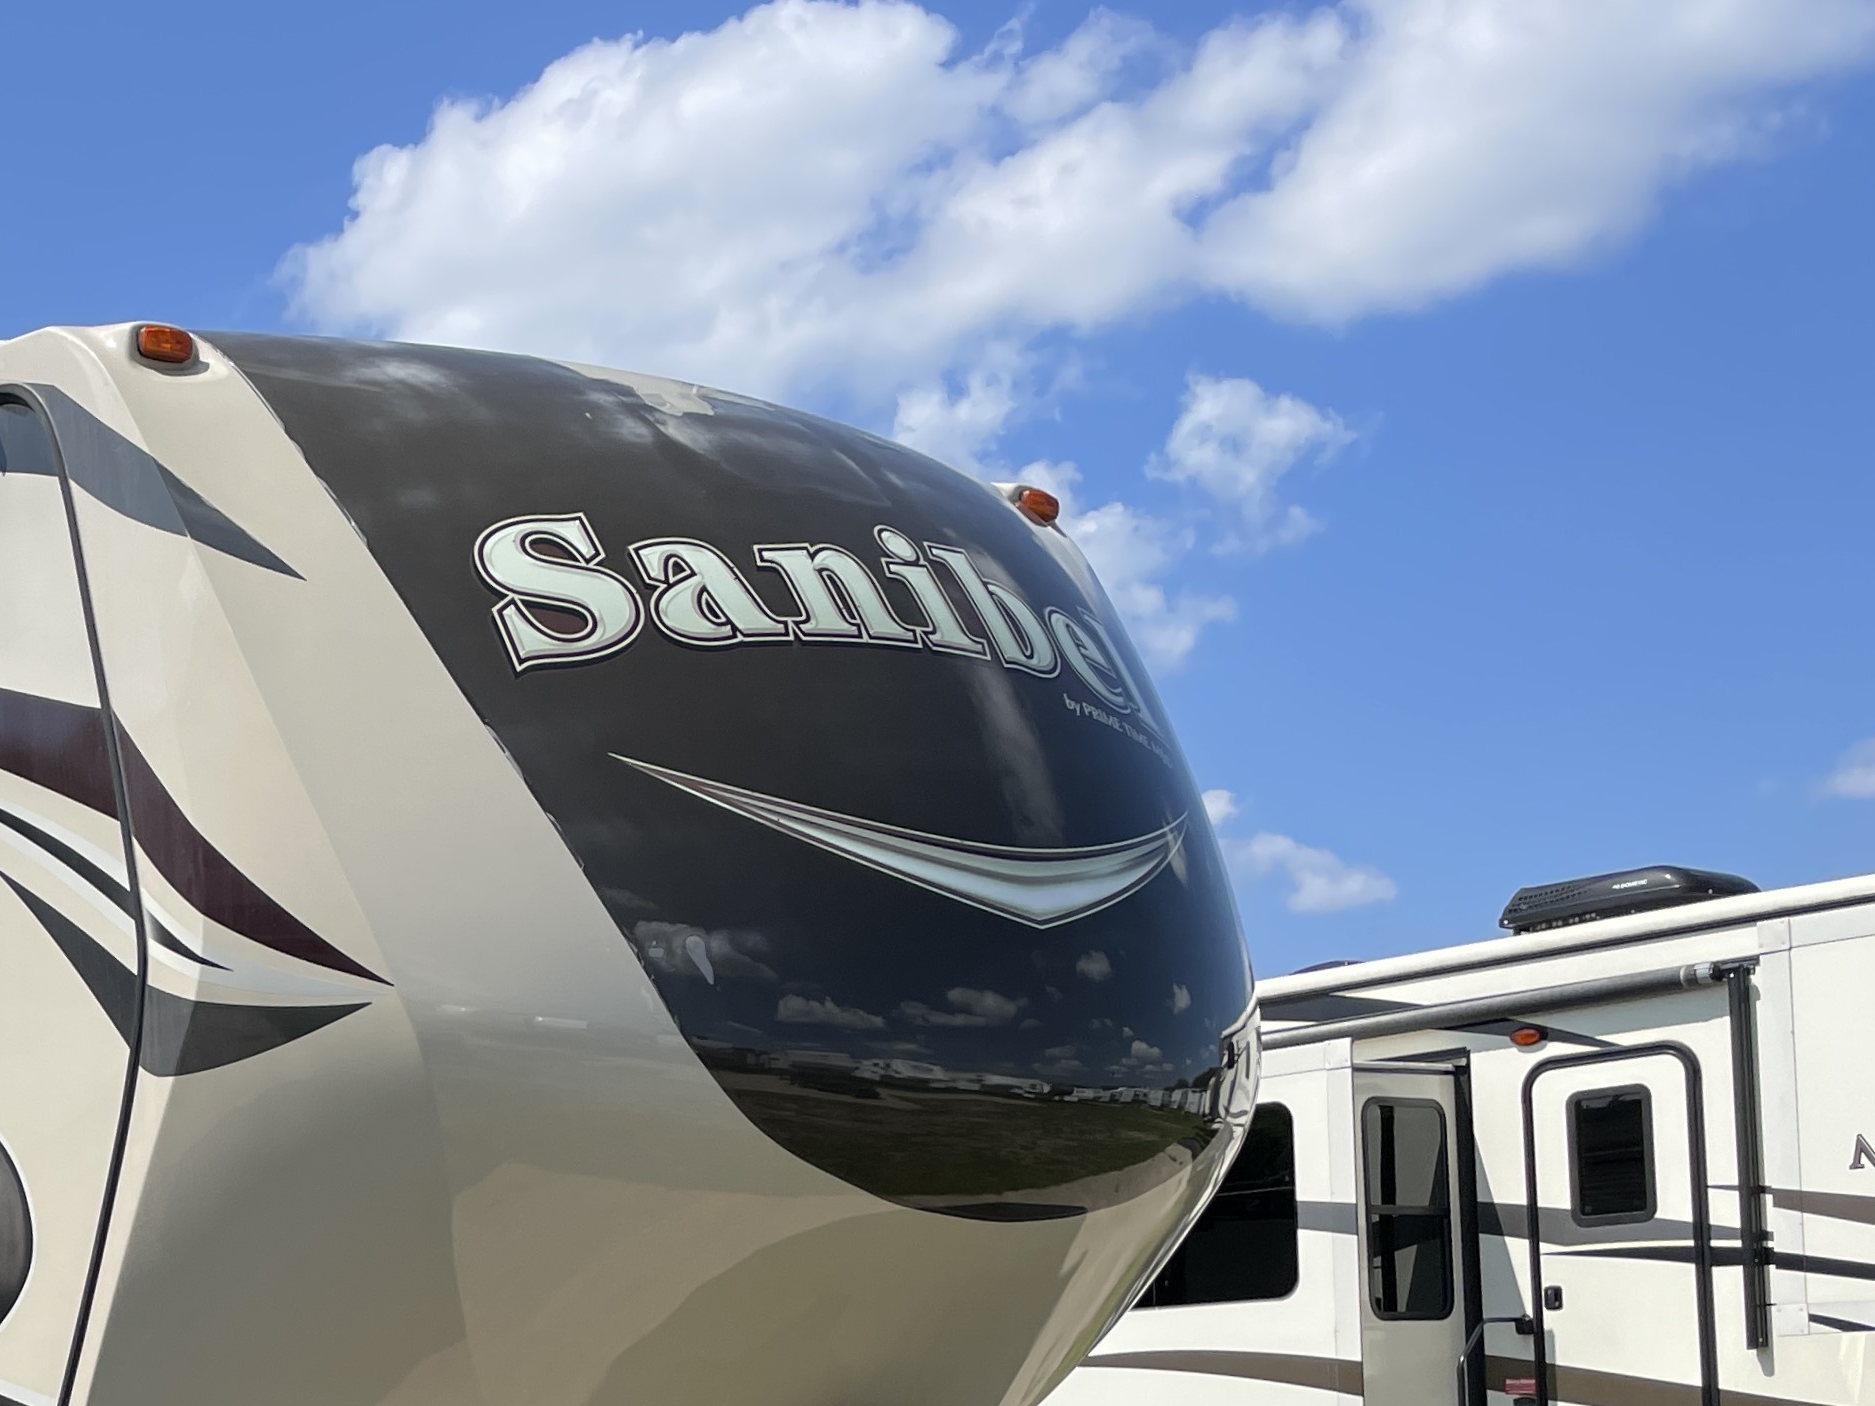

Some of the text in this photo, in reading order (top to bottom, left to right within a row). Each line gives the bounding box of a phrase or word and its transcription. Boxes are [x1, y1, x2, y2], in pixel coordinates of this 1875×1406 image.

[473, 511, 1175, 752] Sanibel
[1063, 692, 1081, 717] by
[1082, 702, 1124, 733] PRIME
